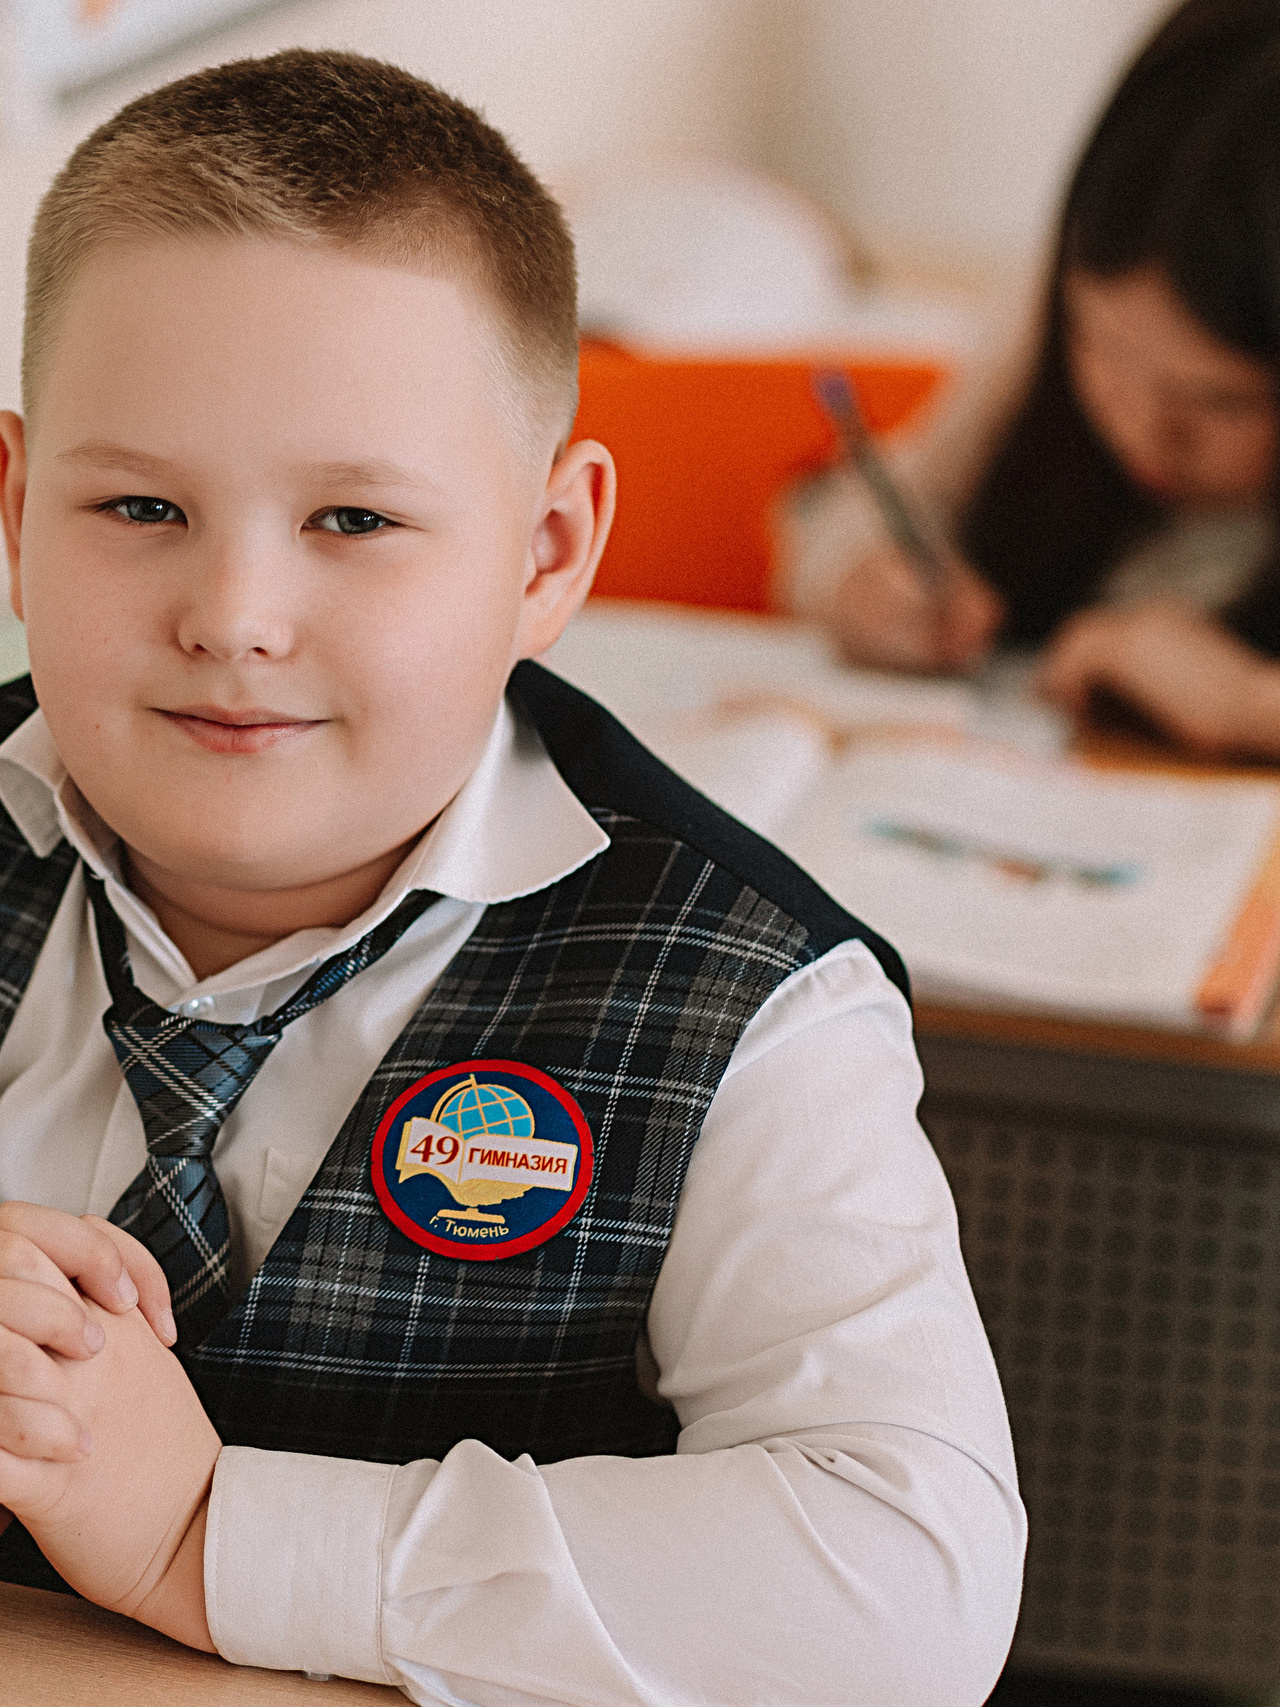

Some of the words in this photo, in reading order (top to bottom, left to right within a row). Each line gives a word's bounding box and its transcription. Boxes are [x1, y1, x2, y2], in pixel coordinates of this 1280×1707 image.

[410, 1134, 460, 1166] 49
[468, 1147, 569, 1175] ГИМНАЗИЯ
[429, 1215, 440, 1229] г.
[445, 1219, 509, 1239] Тюмень
